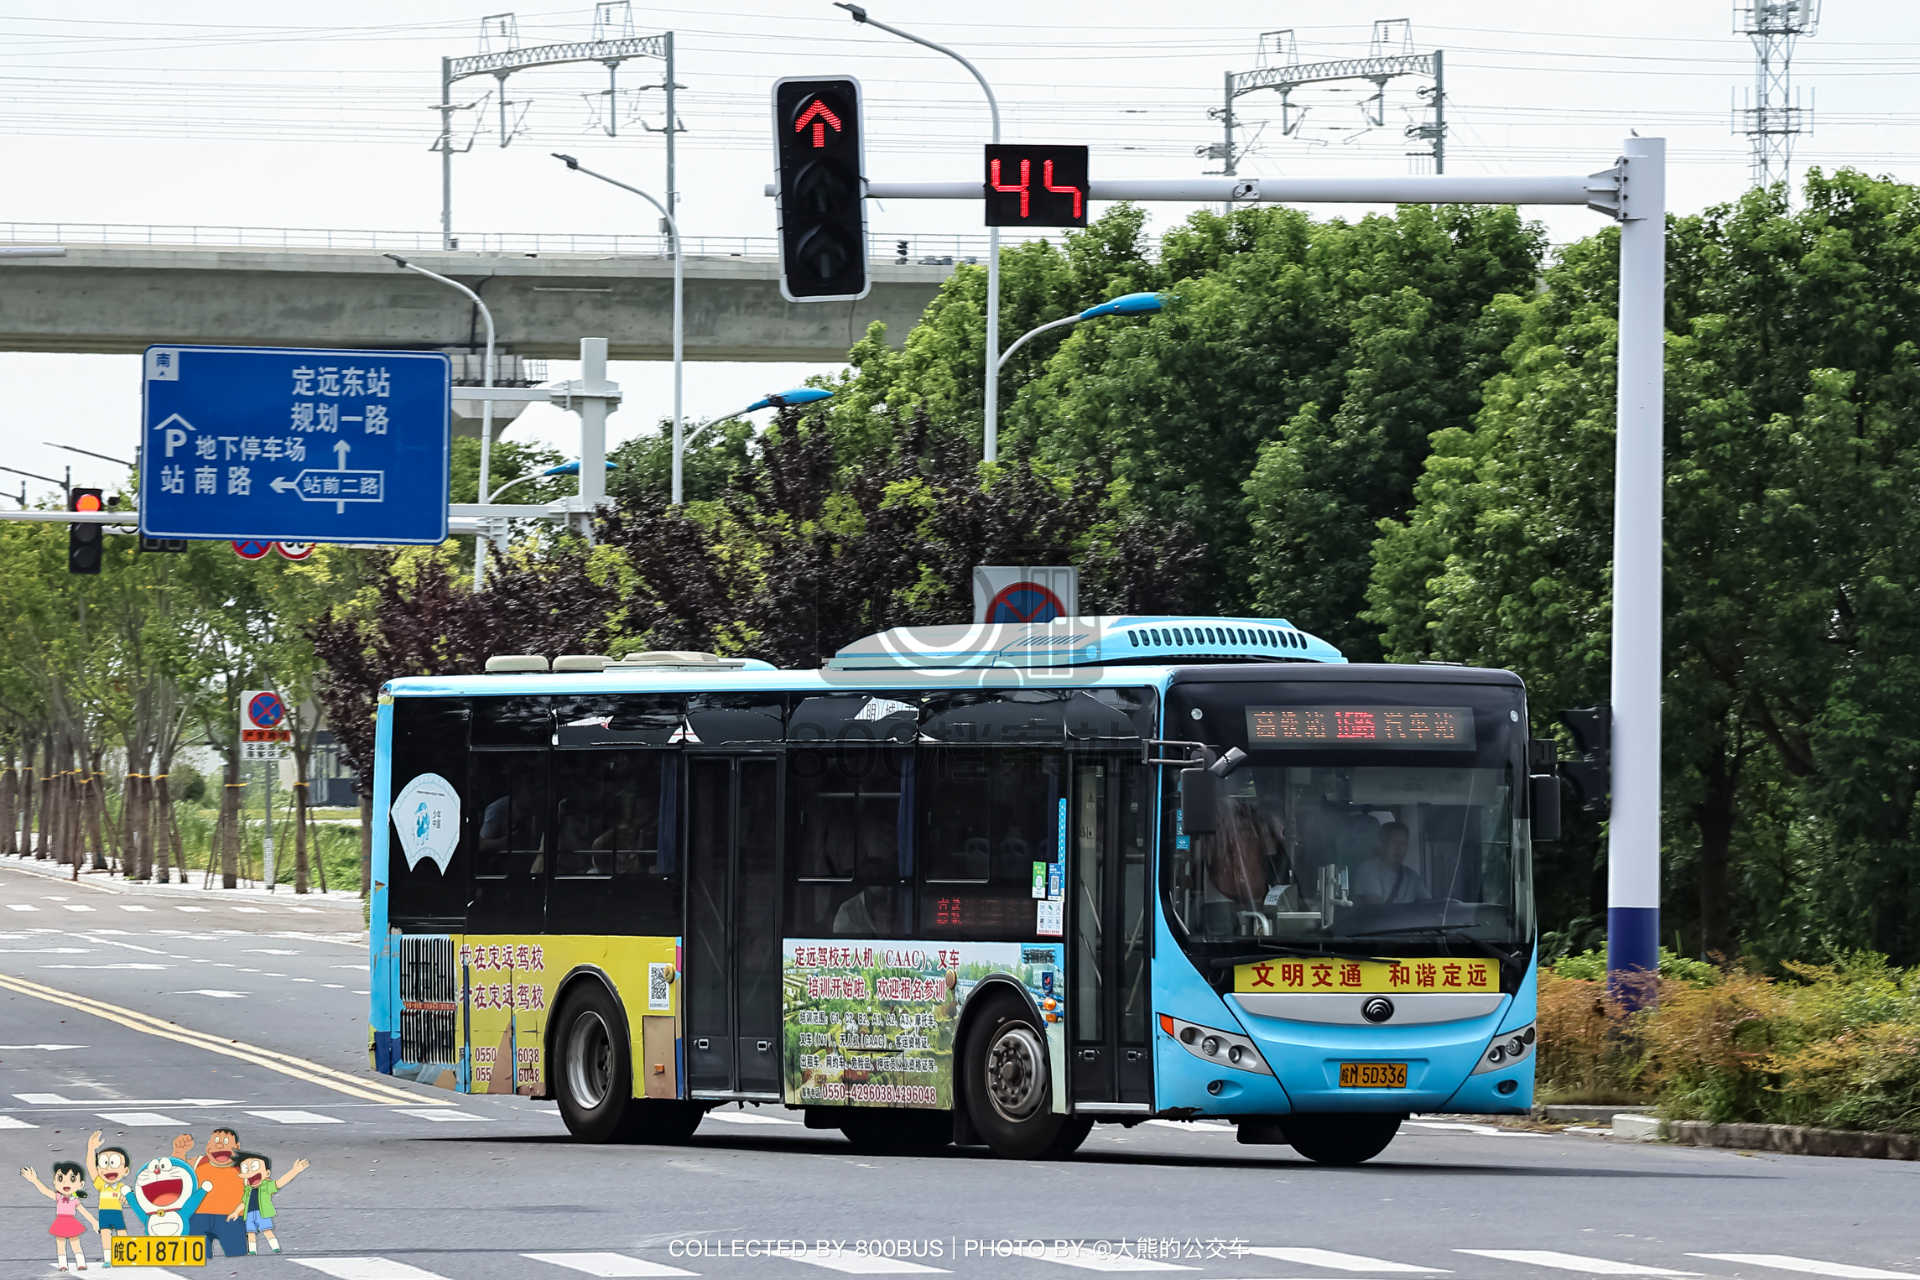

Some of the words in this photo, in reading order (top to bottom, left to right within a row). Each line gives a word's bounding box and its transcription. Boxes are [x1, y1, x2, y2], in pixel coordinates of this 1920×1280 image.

[156, 353, 171, 368] 南
[291, 366, 391, 398] 定远东站
[290, 402, 390, 435] 规划一路
[195, 435, 306, 462] 地下停车场
[161, 465, 252, 496] 站南路
[302, 476, 380, 495] 站前二路
[1384, 712, 1455, 739] 汽车站
[1251, 962, 1362, 988] 文明交通
[1388, 963, 1488, 988] 和谐定远
[459, 983, 545, 1010] 在定远驾校
